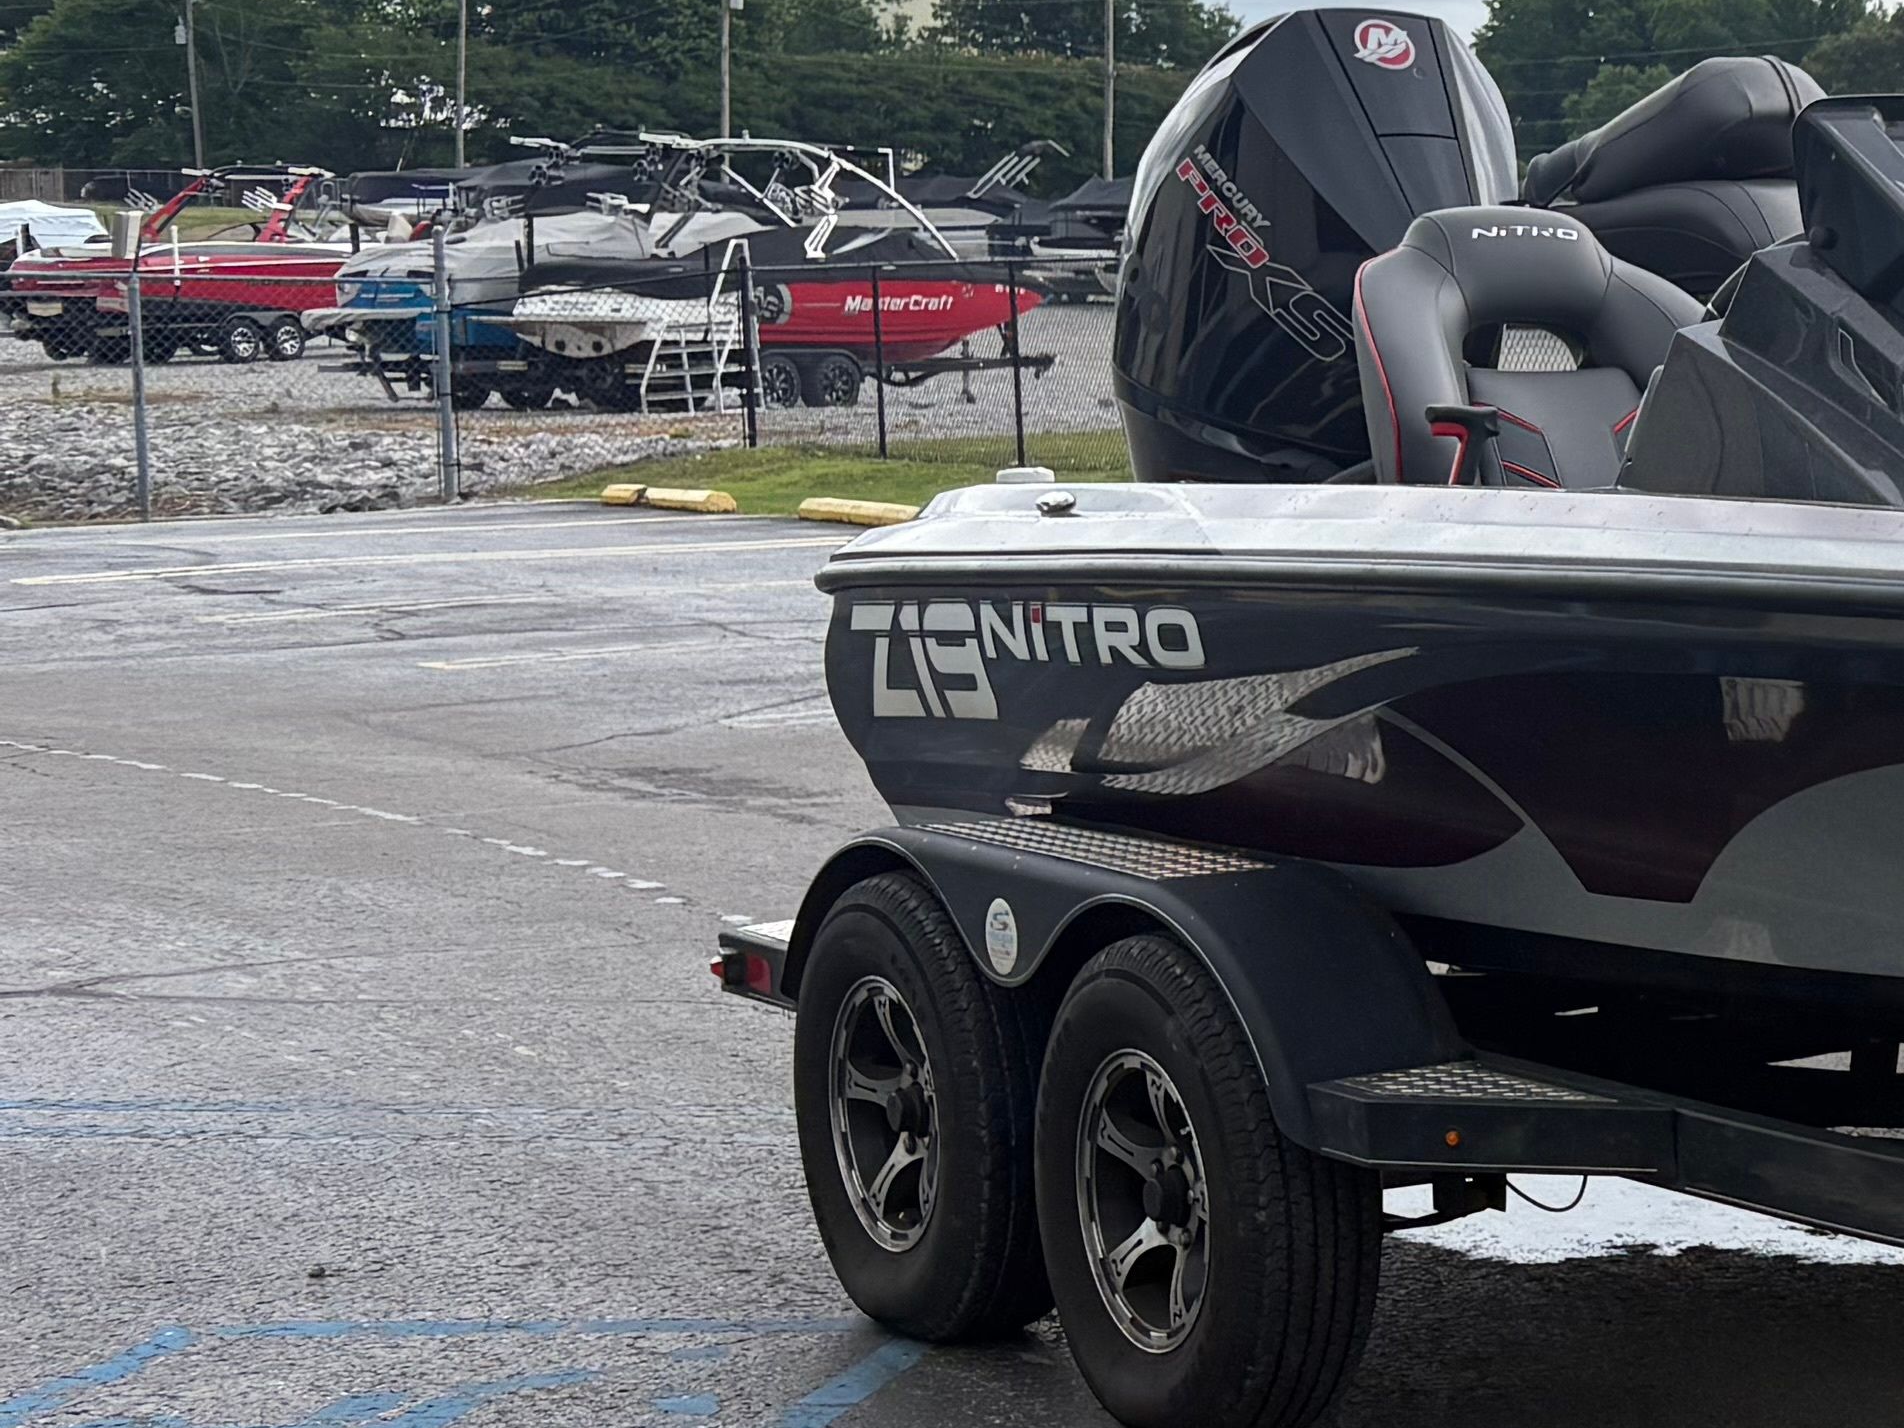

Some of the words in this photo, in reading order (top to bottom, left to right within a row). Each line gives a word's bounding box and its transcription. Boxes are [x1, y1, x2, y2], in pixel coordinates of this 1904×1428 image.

[1176, 157, 1270, 269] PRO
[1193, 144, 1271, 229] MERCURY
[850, 599, 999, 720] Z19
